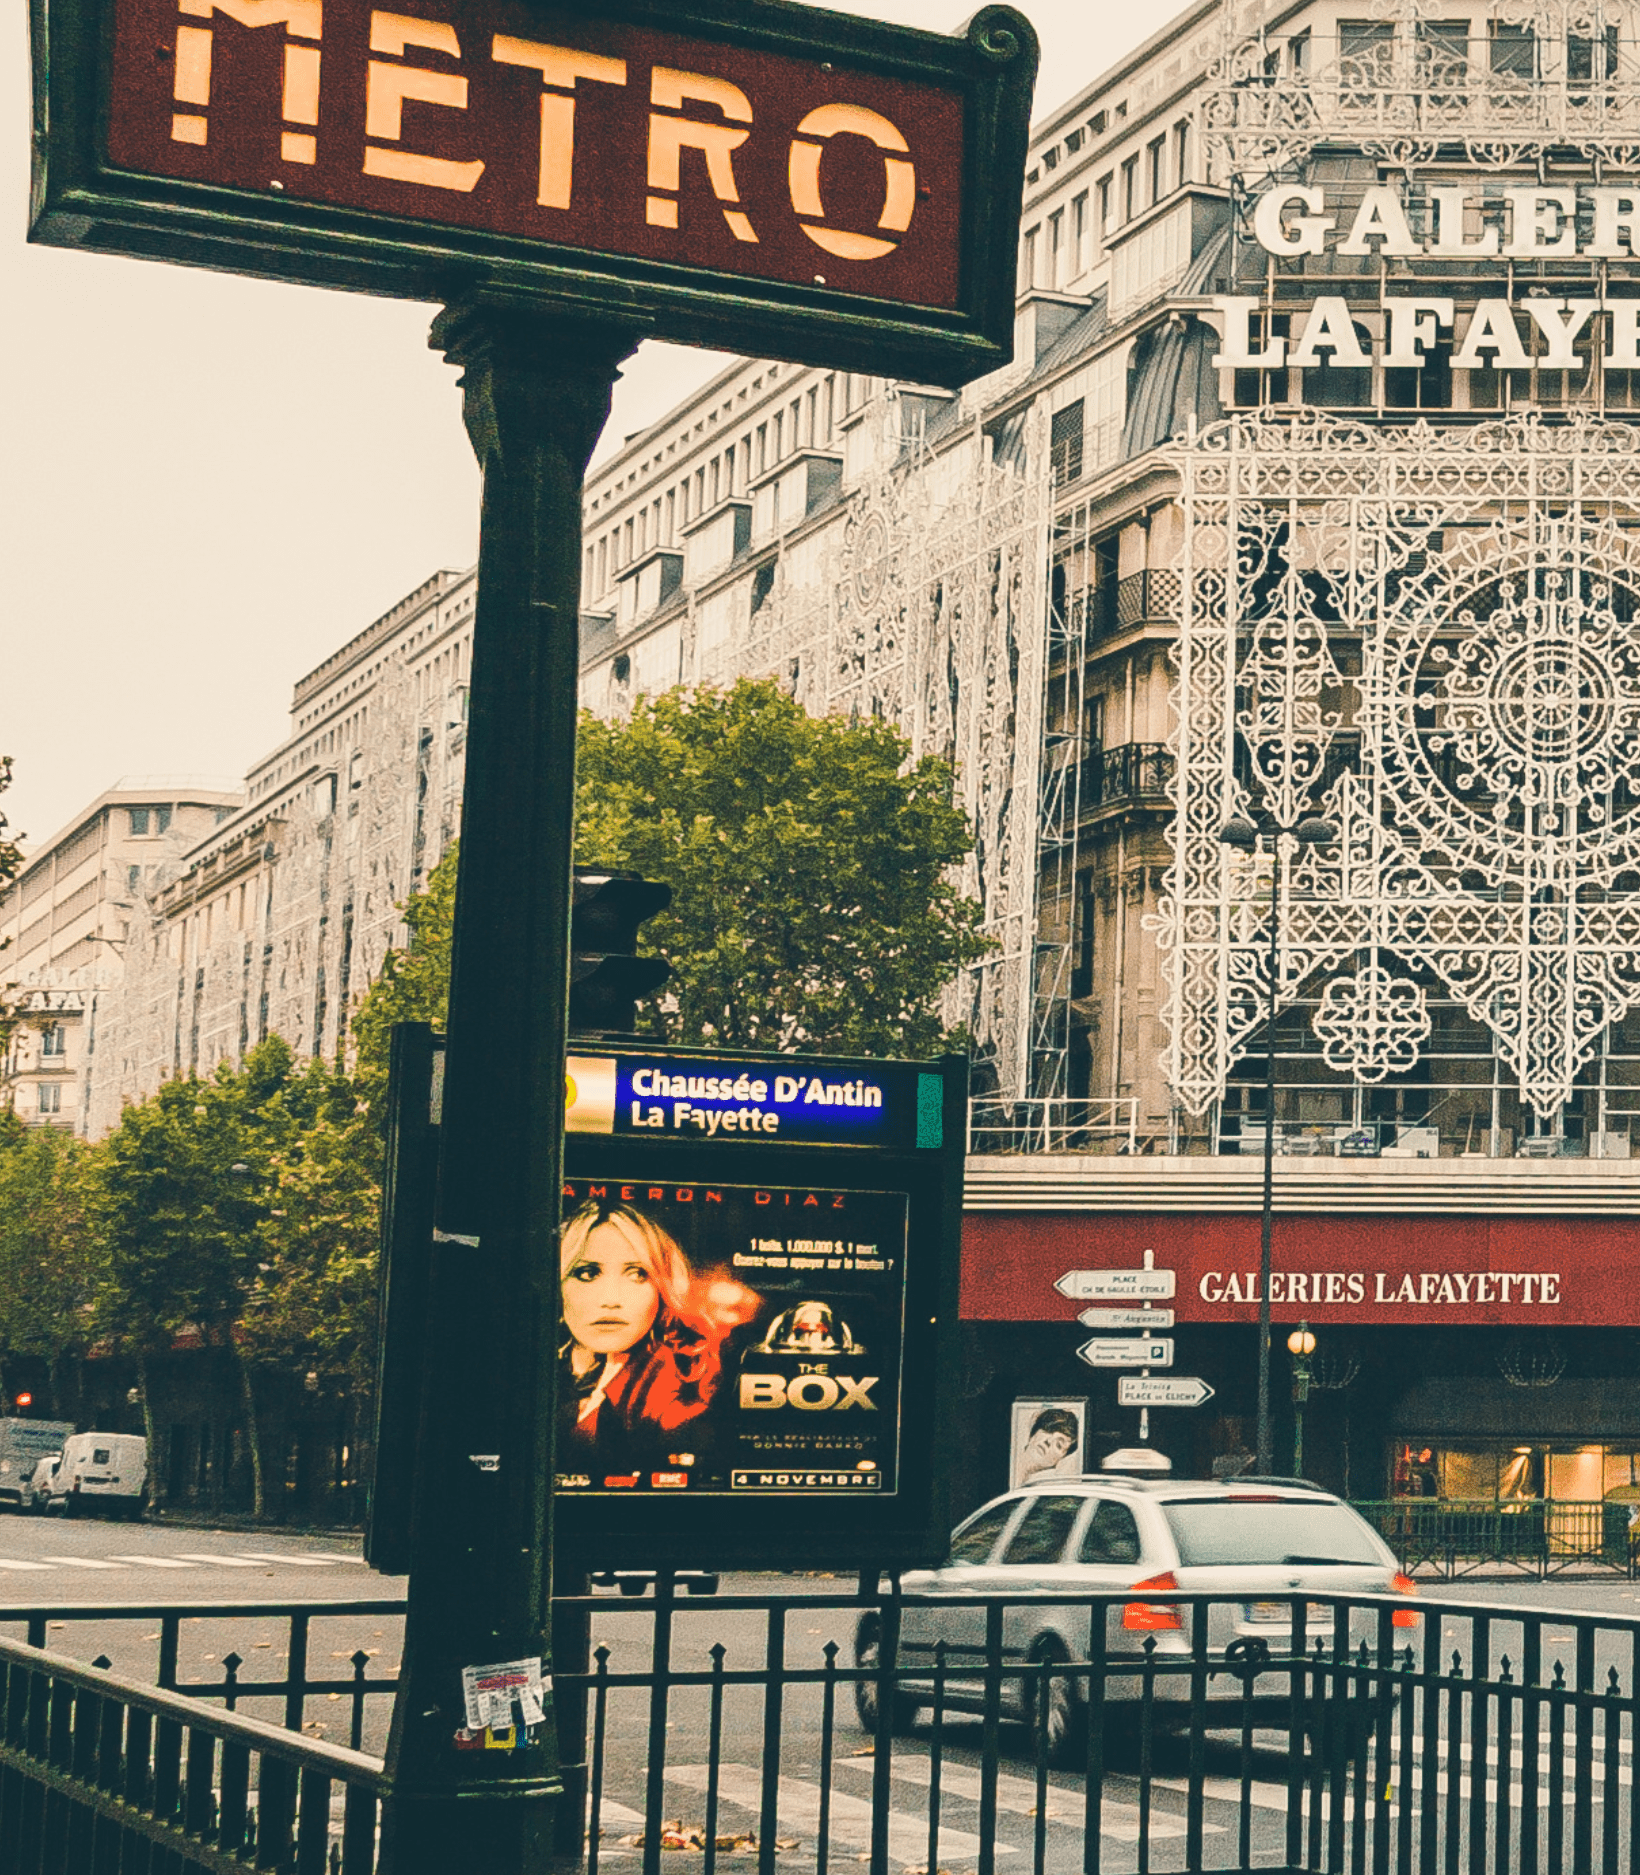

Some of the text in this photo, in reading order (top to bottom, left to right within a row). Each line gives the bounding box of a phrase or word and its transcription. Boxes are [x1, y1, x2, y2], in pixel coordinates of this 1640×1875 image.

[171, 0, 917, 262] METRO
[631, 1069, 768, 1102] Chaussée
[631, 1101, 780, 1137] La Fayette
[563, 1185, 846, 1209] AMERON DIAZ
[1112, 1275, 1137, 1283] PLACE
[1199, 1271, 1561, 1304] GALERIES LAFAYETTE
[798, 1363, 829, 1375] THE
[739, 1373, 881, 1411] BOX
[1124, 1392, 1152, 1401] PLACE
[1165, 1392, 1197, 1401] CLICHY
[736, 1474, 877, 1486] 4 NOVEMBRE
